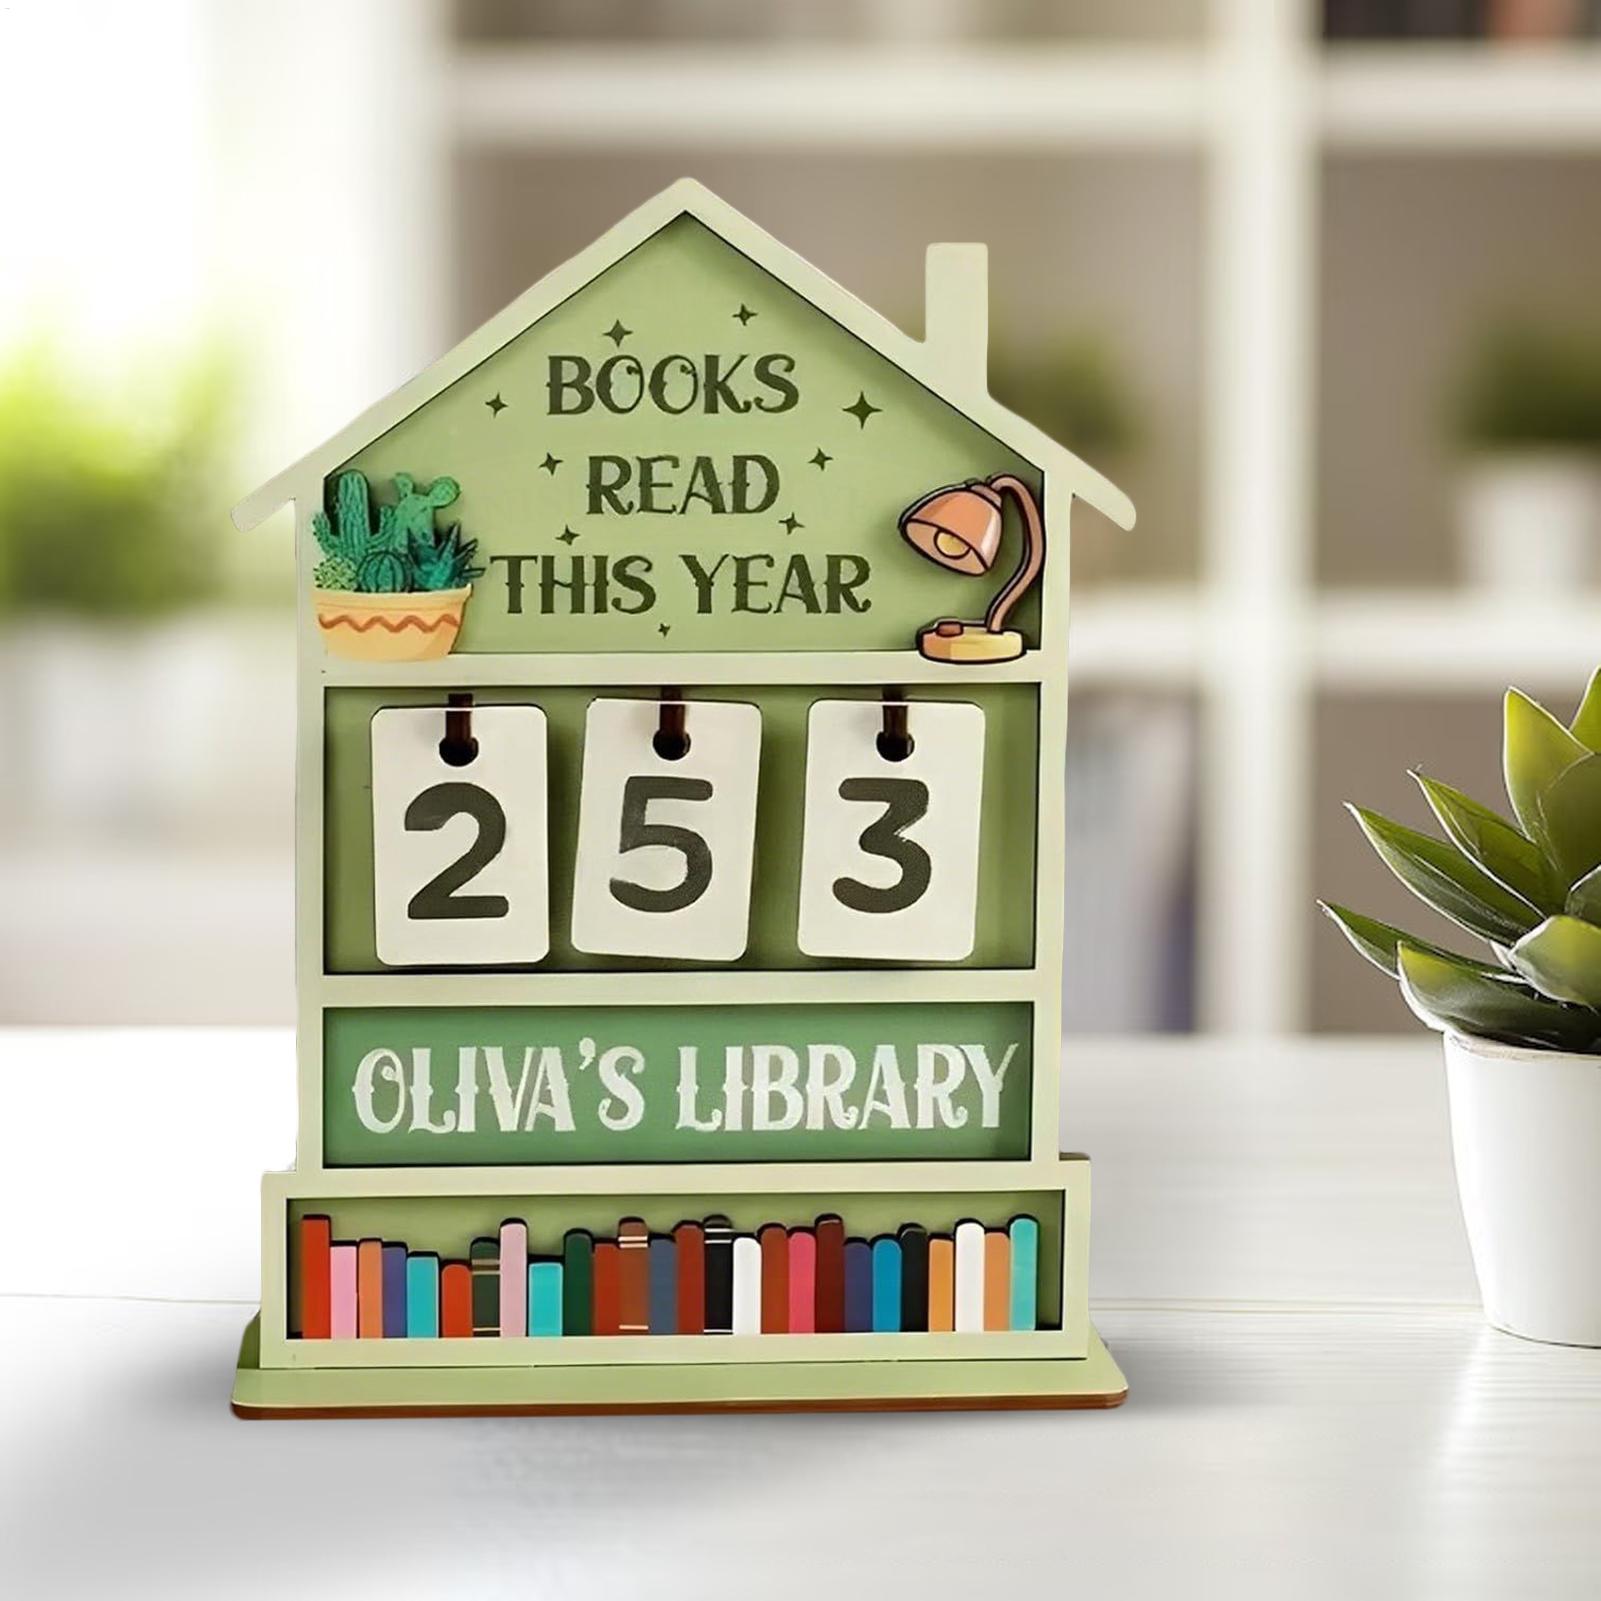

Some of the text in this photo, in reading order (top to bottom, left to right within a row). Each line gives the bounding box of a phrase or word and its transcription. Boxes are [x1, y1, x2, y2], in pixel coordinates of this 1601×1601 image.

[546, 354, 799, 415] BOOKS
[586, 455, 779, 515] READ
[490, 554, 872, 615] THIS YEAR
[352, 1037, 1018, 1134] OLIVA'S LIBRARY
